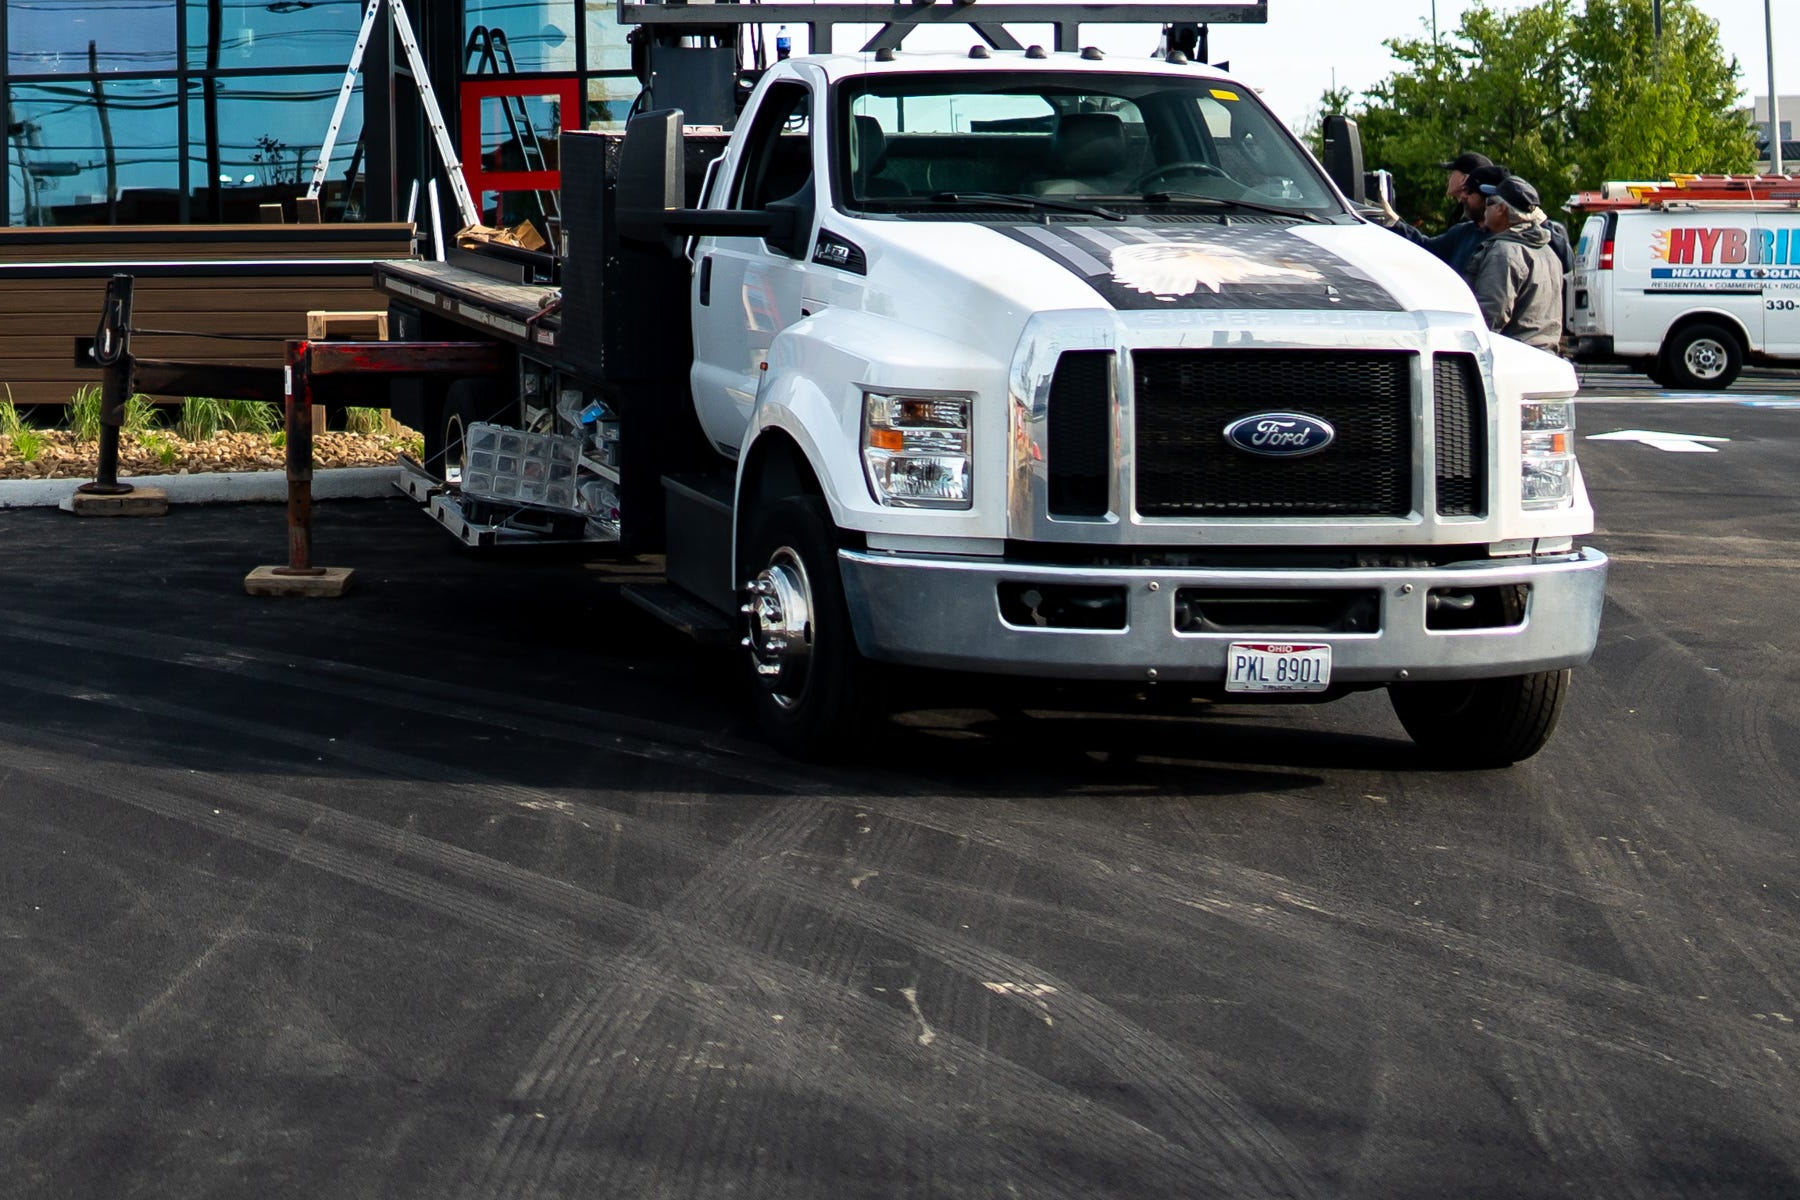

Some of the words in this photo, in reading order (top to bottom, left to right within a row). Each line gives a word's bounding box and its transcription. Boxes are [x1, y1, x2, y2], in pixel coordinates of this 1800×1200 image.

[1671, 268, 1732, 278] HEATING
[1735, 269, 1747, 278] &
[1251, 419, 1311, 447] Ford
[1267, 645, 1293, 653] OHIO
[1235, 656, 1269, 681] PKL
[1277, 658, 1321, 682] 8901
